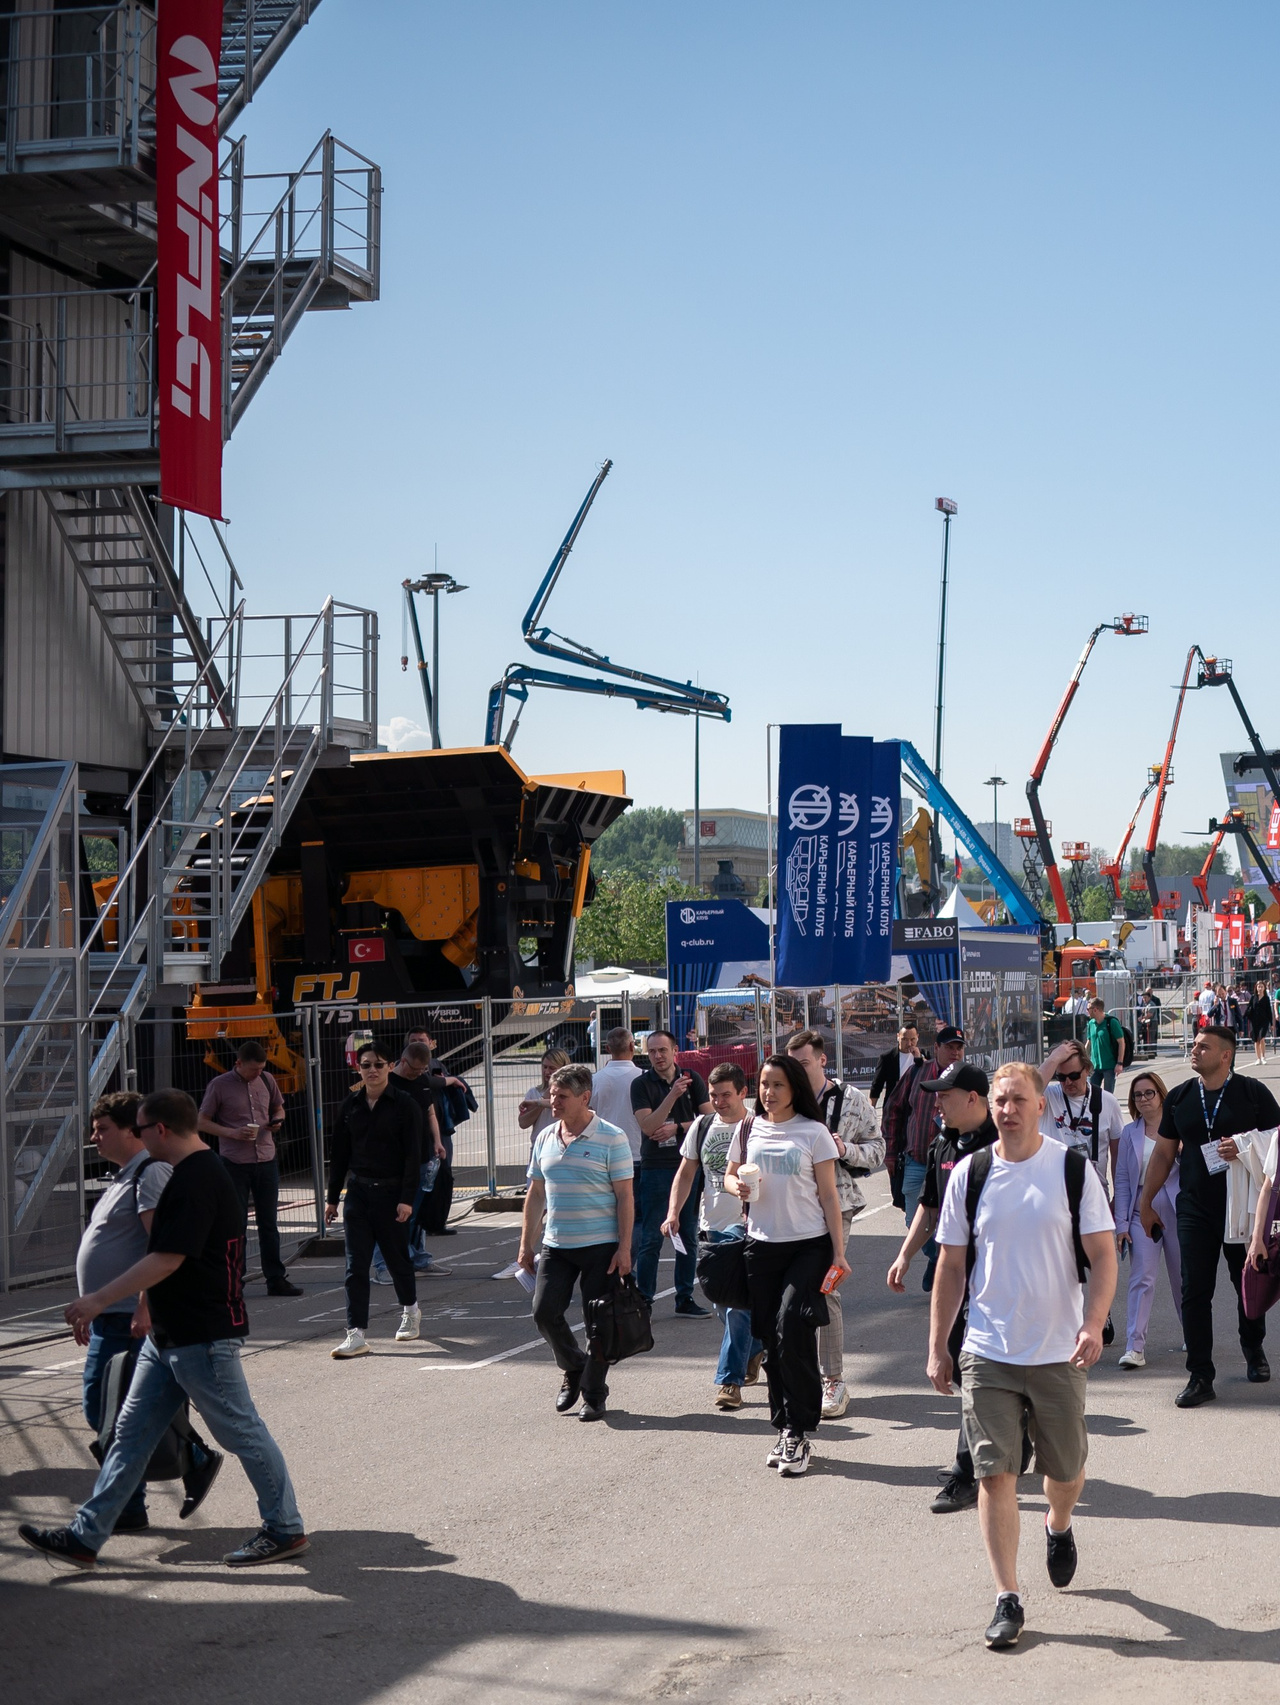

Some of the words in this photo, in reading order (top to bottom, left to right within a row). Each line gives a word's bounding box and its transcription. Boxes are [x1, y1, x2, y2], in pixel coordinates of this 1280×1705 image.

[171, 124, 214, 421] NFLG
[817, 835, 829, 905] КАРЬЕРНЫЙ
[846, 841, 858, 906] КАРЬЕРНЫЙ
[880, 842, 891, 906] КАРЬЕРНЫЙ
[815, 907, 826, 937] КЛУБ
[844, 908, 855, 938] КЛУБ
[879, 908, 889, 936] КЛУБ
[914, 926, 954, 938] FABO
[681, 939, 714, 948] q-club.ru
[292, 971, 360, 1002] FTJ
[427, 1006, 460, 1020] HYBRID
[852, 1067, 858, 1075] А
[860, 1066, 876, 1076] ДЕН
[705, 1132, 729, 1148] LIMITED
